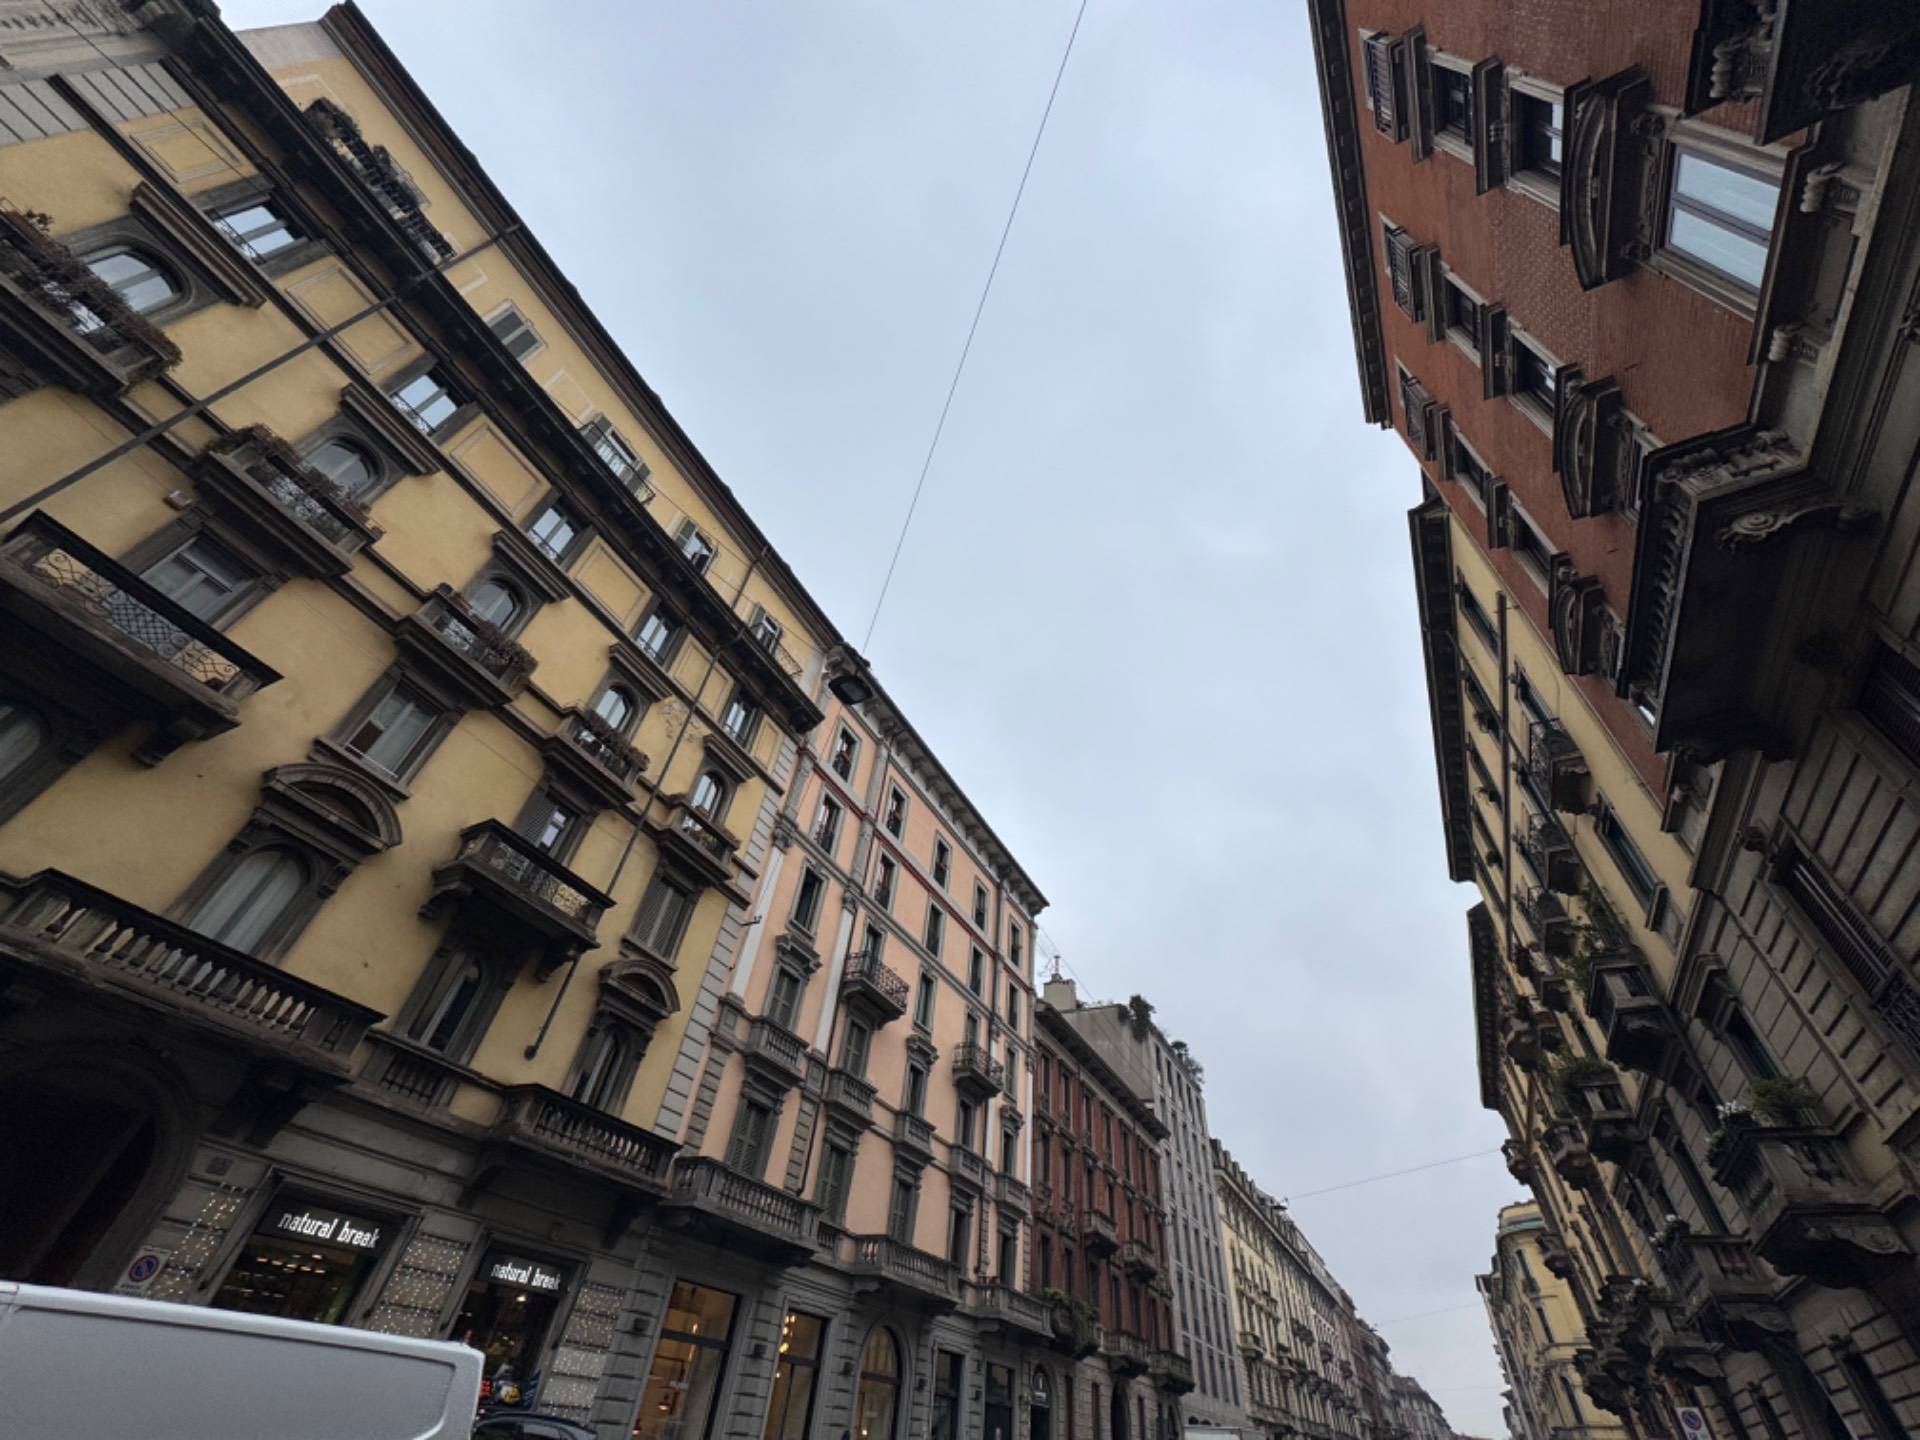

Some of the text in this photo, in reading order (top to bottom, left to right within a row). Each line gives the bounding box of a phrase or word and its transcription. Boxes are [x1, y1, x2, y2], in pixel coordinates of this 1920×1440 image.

[278, 1212, 382, 1249] natural break
[490, 1262, 561, 1291] natural break
